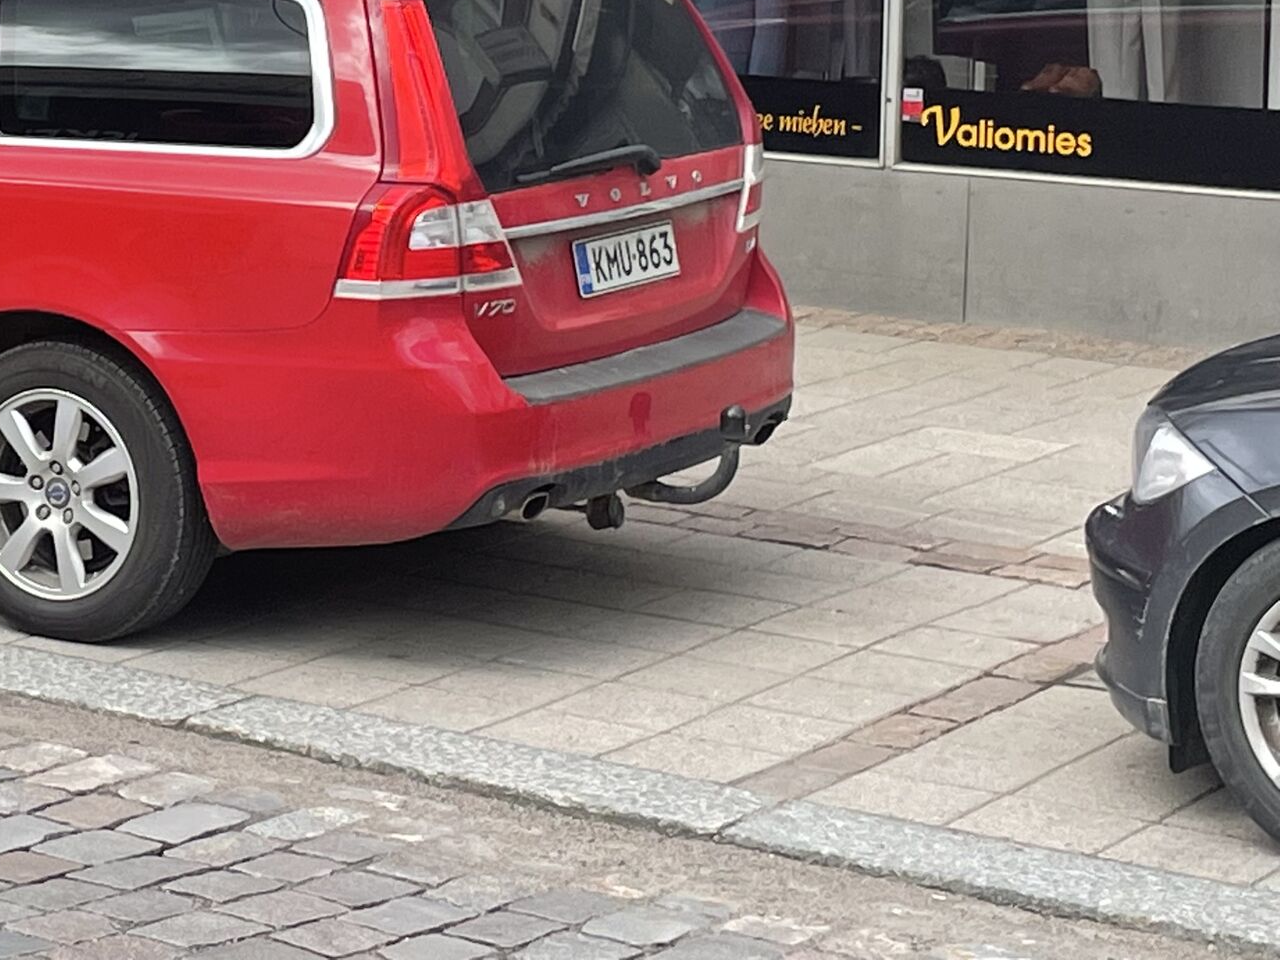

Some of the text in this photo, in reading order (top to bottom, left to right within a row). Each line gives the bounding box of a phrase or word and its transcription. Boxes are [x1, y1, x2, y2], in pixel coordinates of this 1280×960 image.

[780, 105, 847, 137] miehen
[921, 104, 1093, 158] Valiomies
[575, 169, 703, 208] VOLVO
[591, 230, 674, 285] KMU-863
[473, 298, 517, 318] V70
